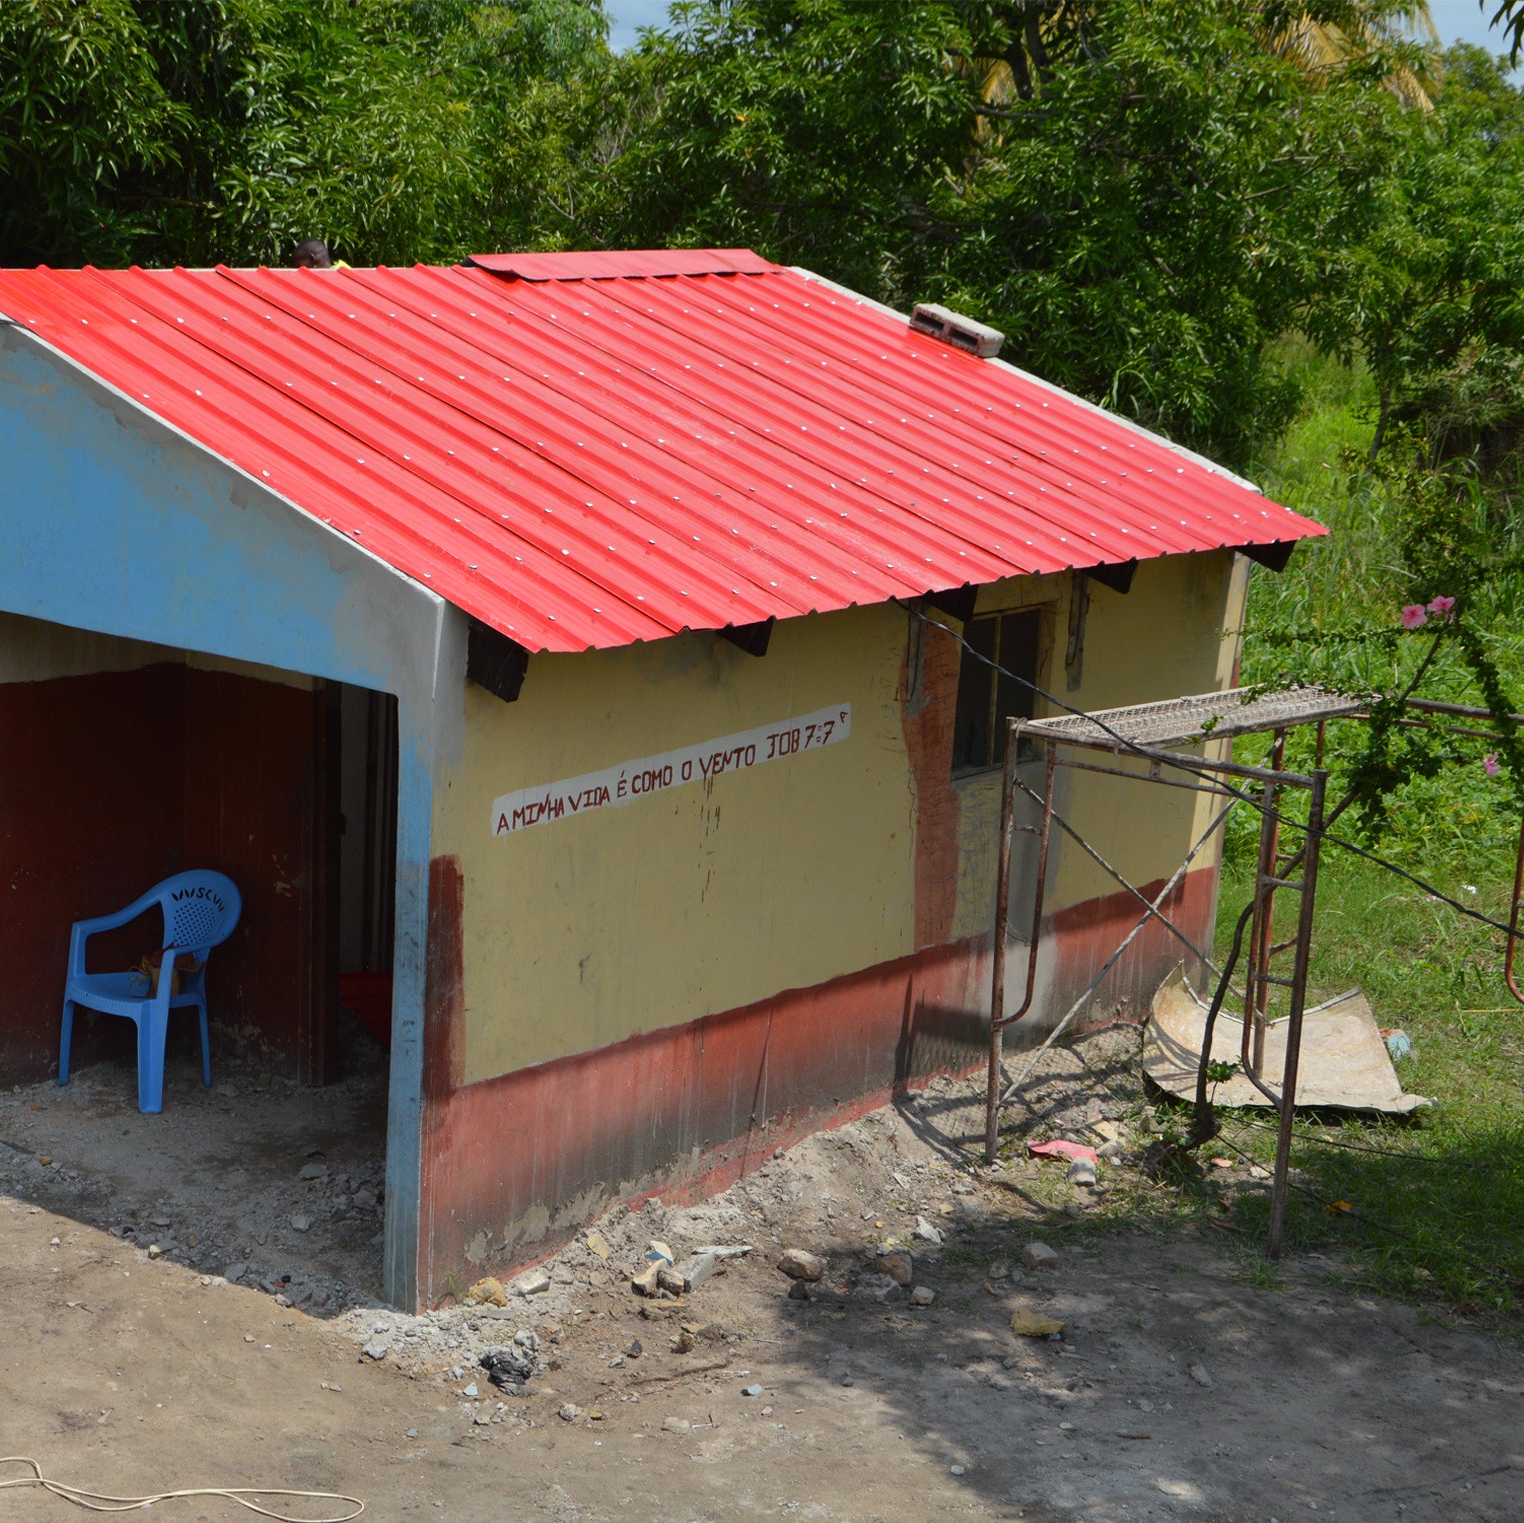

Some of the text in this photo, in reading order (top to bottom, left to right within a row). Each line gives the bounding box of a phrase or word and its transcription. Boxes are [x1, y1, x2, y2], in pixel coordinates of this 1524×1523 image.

[497, 812, 509, 835] A
[513, 793, 565, 830] MINHA
[568, 786, 611, 812] VIDA
[617, 770, 627, 798] É
[632, 765, 673, 794] COMO
[681, 760, 692, 781] O
[699, 745, 756, 777] VENTO
[766, 728, 800, 759] JOB
